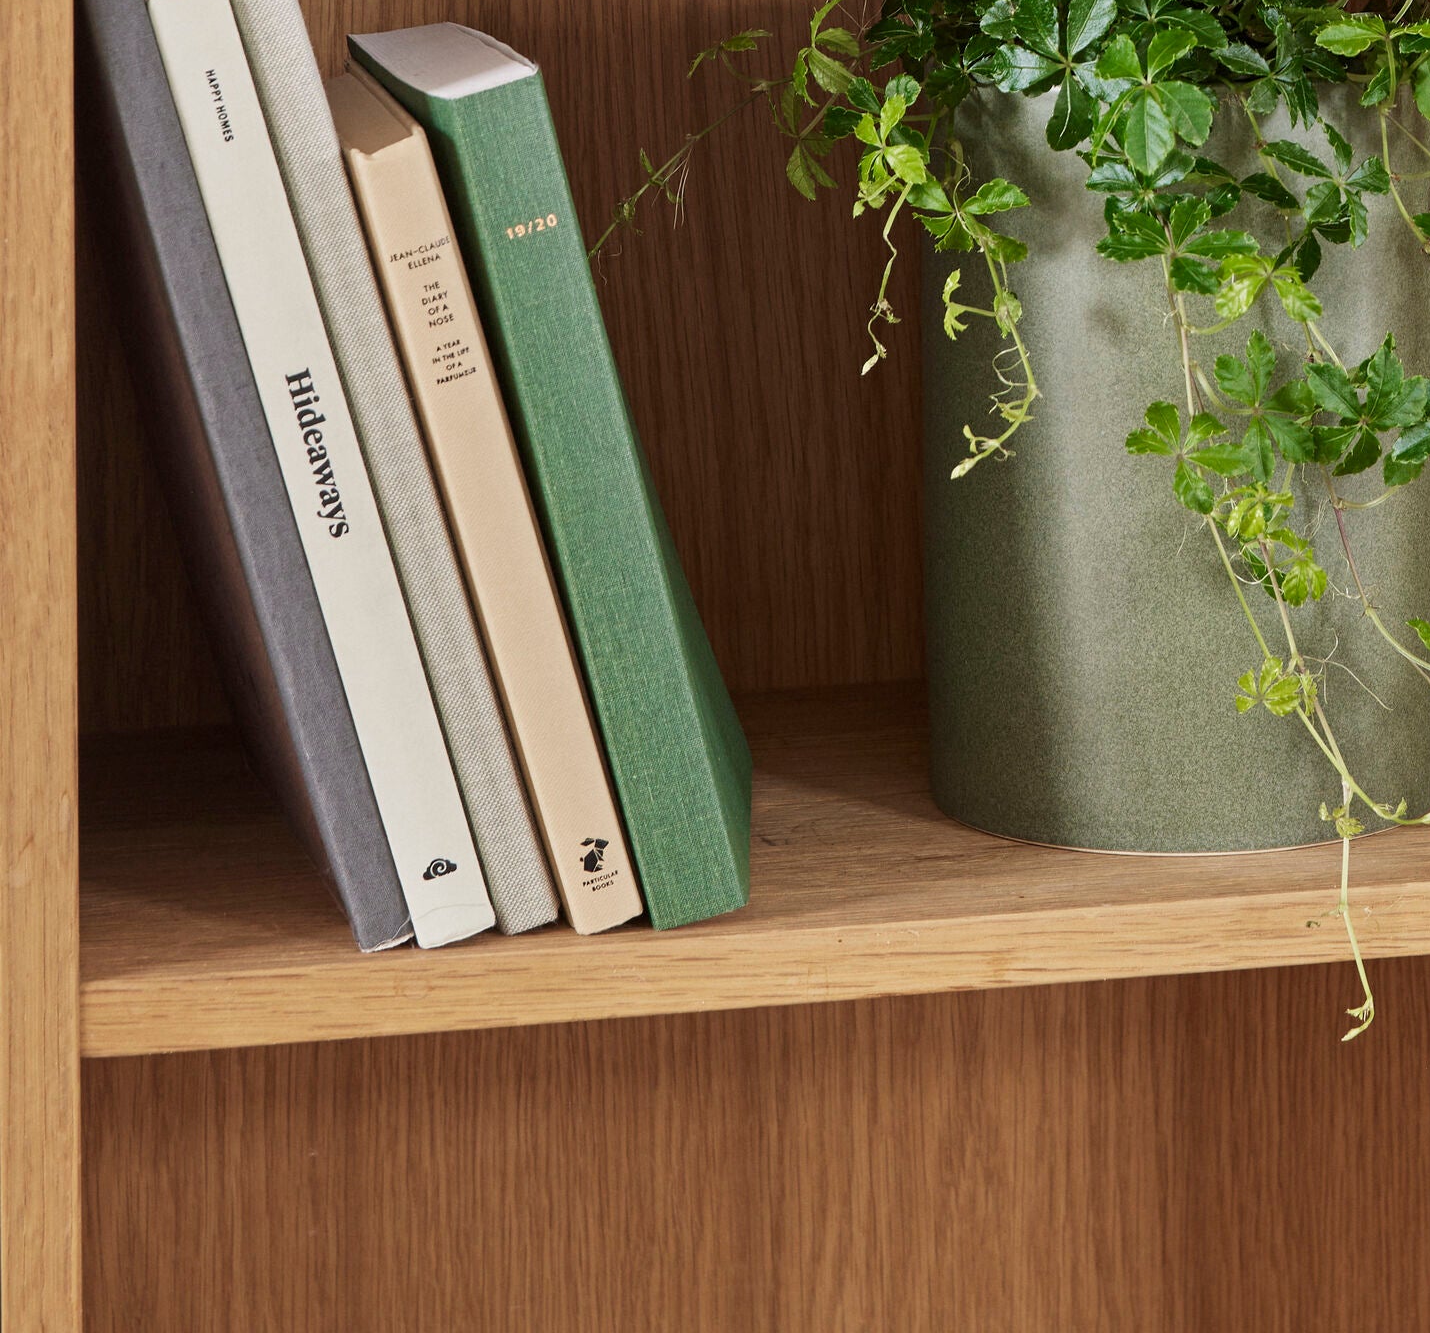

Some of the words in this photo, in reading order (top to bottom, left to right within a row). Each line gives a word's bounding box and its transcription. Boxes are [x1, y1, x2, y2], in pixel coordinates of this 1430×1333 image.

[205, 69, 223, 102] HAPPY
[216, 105, 234, 142] HOMES
[507, 213, 557, 240] 19/20
[389, 235, 450, 263] JEAN-CLAUDE
[408, 253, 441, 269] ELLENA
[424, 281, 440, 292] THE
[422, 290, 448, 305] DIARY
[428, 306, 439, 315] OF
[429, 313, 454, 328] NOSE
[443, 339, 460, 349] YEAR
[442, 352, 455, 361] THE
[285, 367, 349, 538] Hideaways
[583, 870, 618, 887] PARTICULAR
[592, 880, 614, 892] BOOKS
